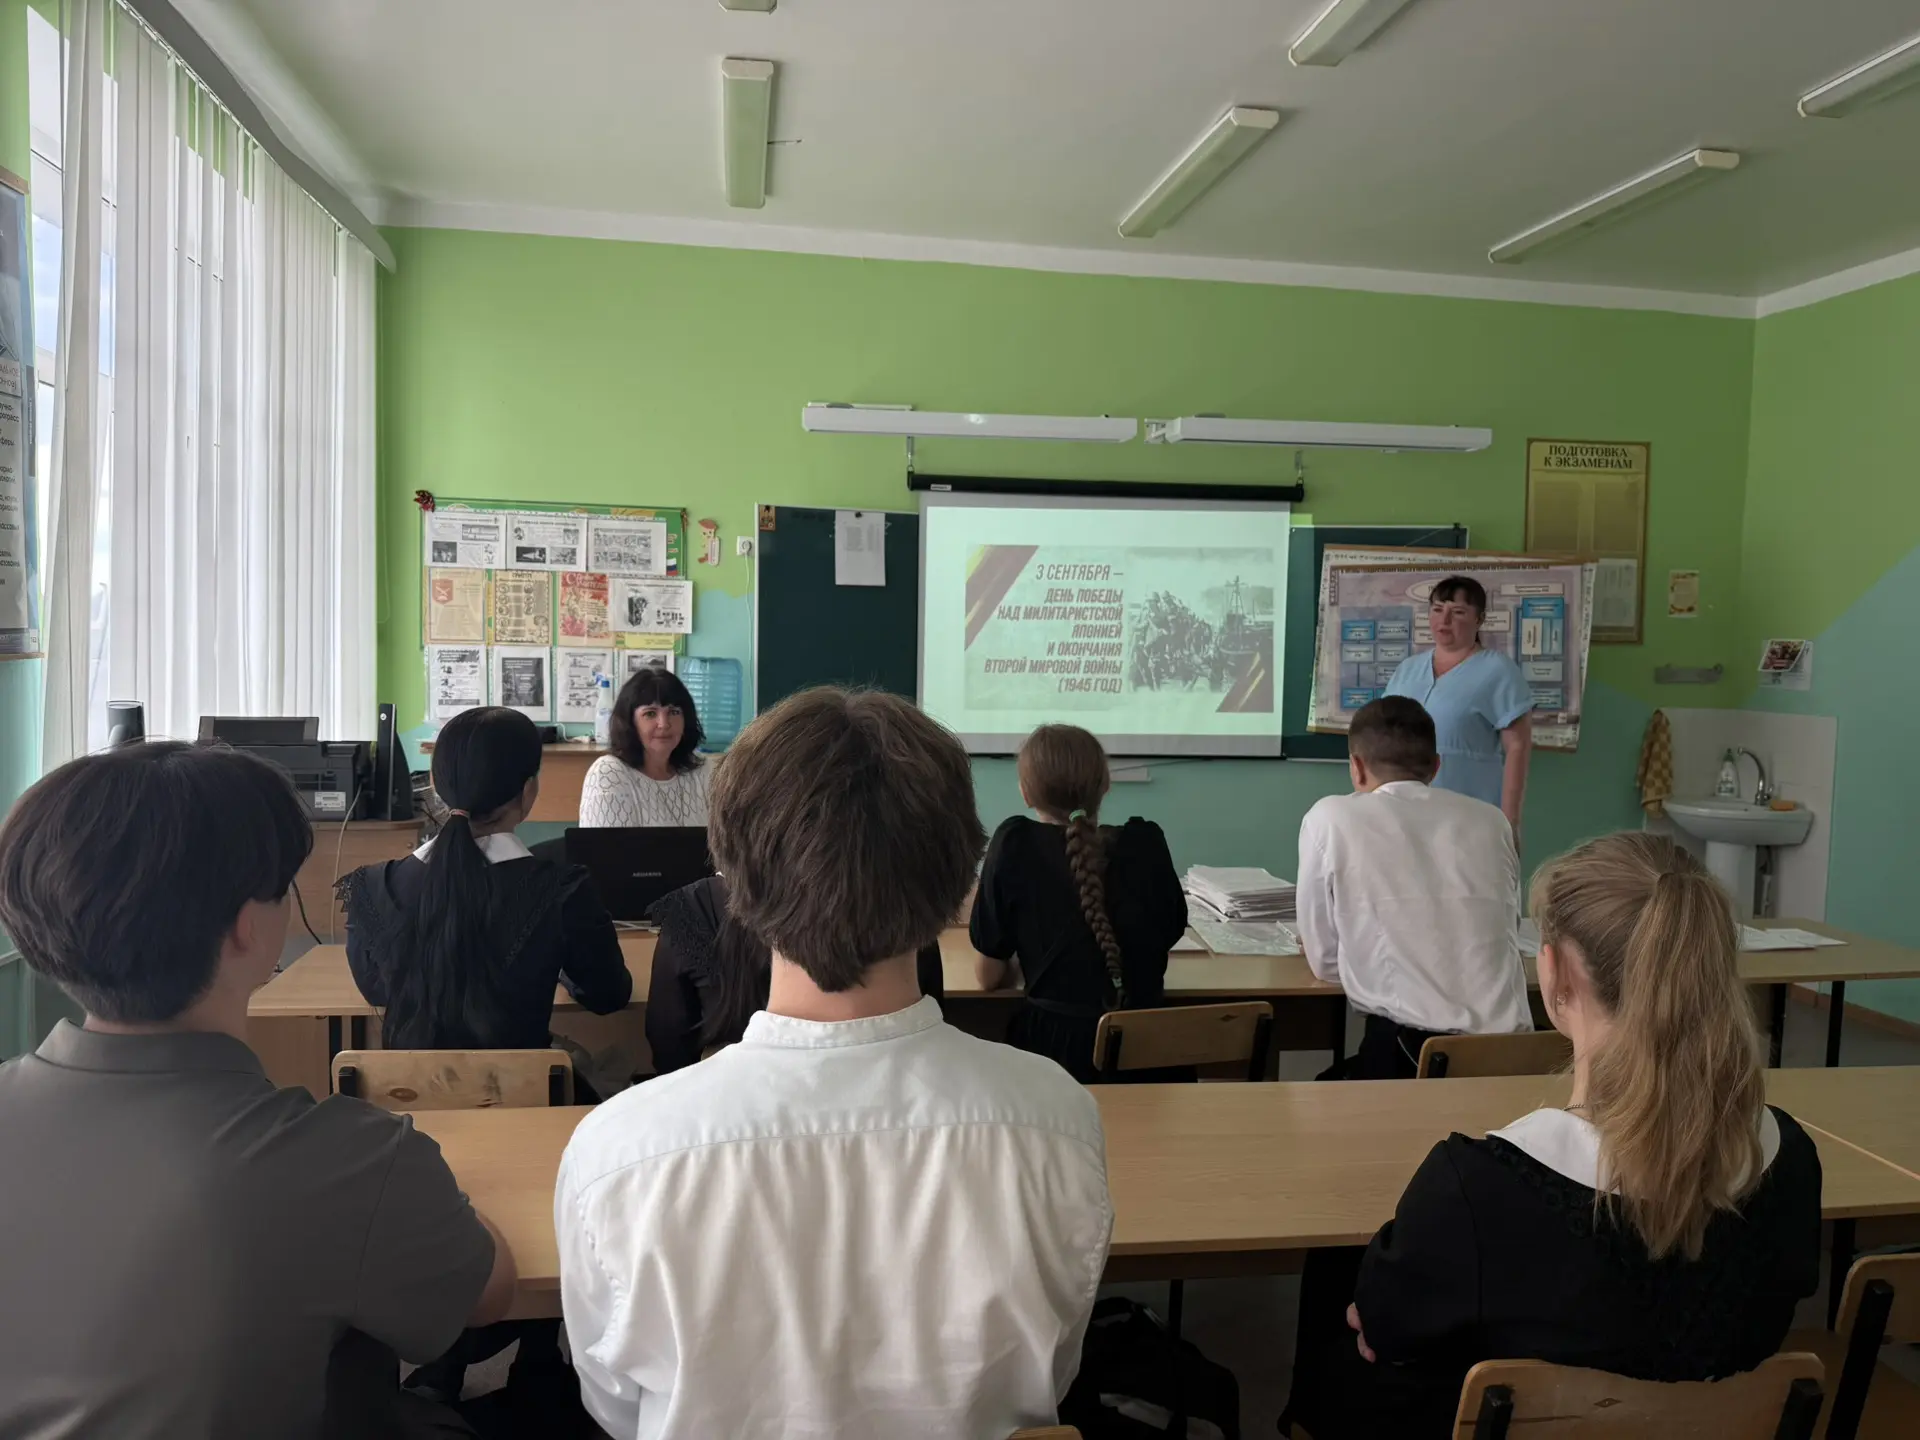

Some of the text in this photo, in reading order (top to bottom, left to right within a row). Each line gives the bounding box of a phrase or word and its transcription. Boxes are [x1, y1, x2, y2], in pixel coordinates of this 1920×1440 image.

[1549, 444, 1628, 457] ПОДГОТОВКА
[1544, 456, 1632, 469] К ЭКЗАМЕНАМ
[1036, 564, 1045, 580] 3
[1046, 564, 1111, 581] СЕНТЯБРЯ
[1044, 588, 1123, 604] ДЕНЬ ПОБЕДЫ
[997, 604, 1123, 621] НАД МИЛИТАРИСТСКОЙ
[1072, 622, 1123, 638] ЯПОНИЕЙ
[1046, 641, 1123, 656] И ОКОНЧАНИЯ
[984, 657, 1123, 674] ВТОРОЙ МИРОВОЙ ВОЙНЫ
[1058, 677, 1123, 693] (1945 ГОД)
